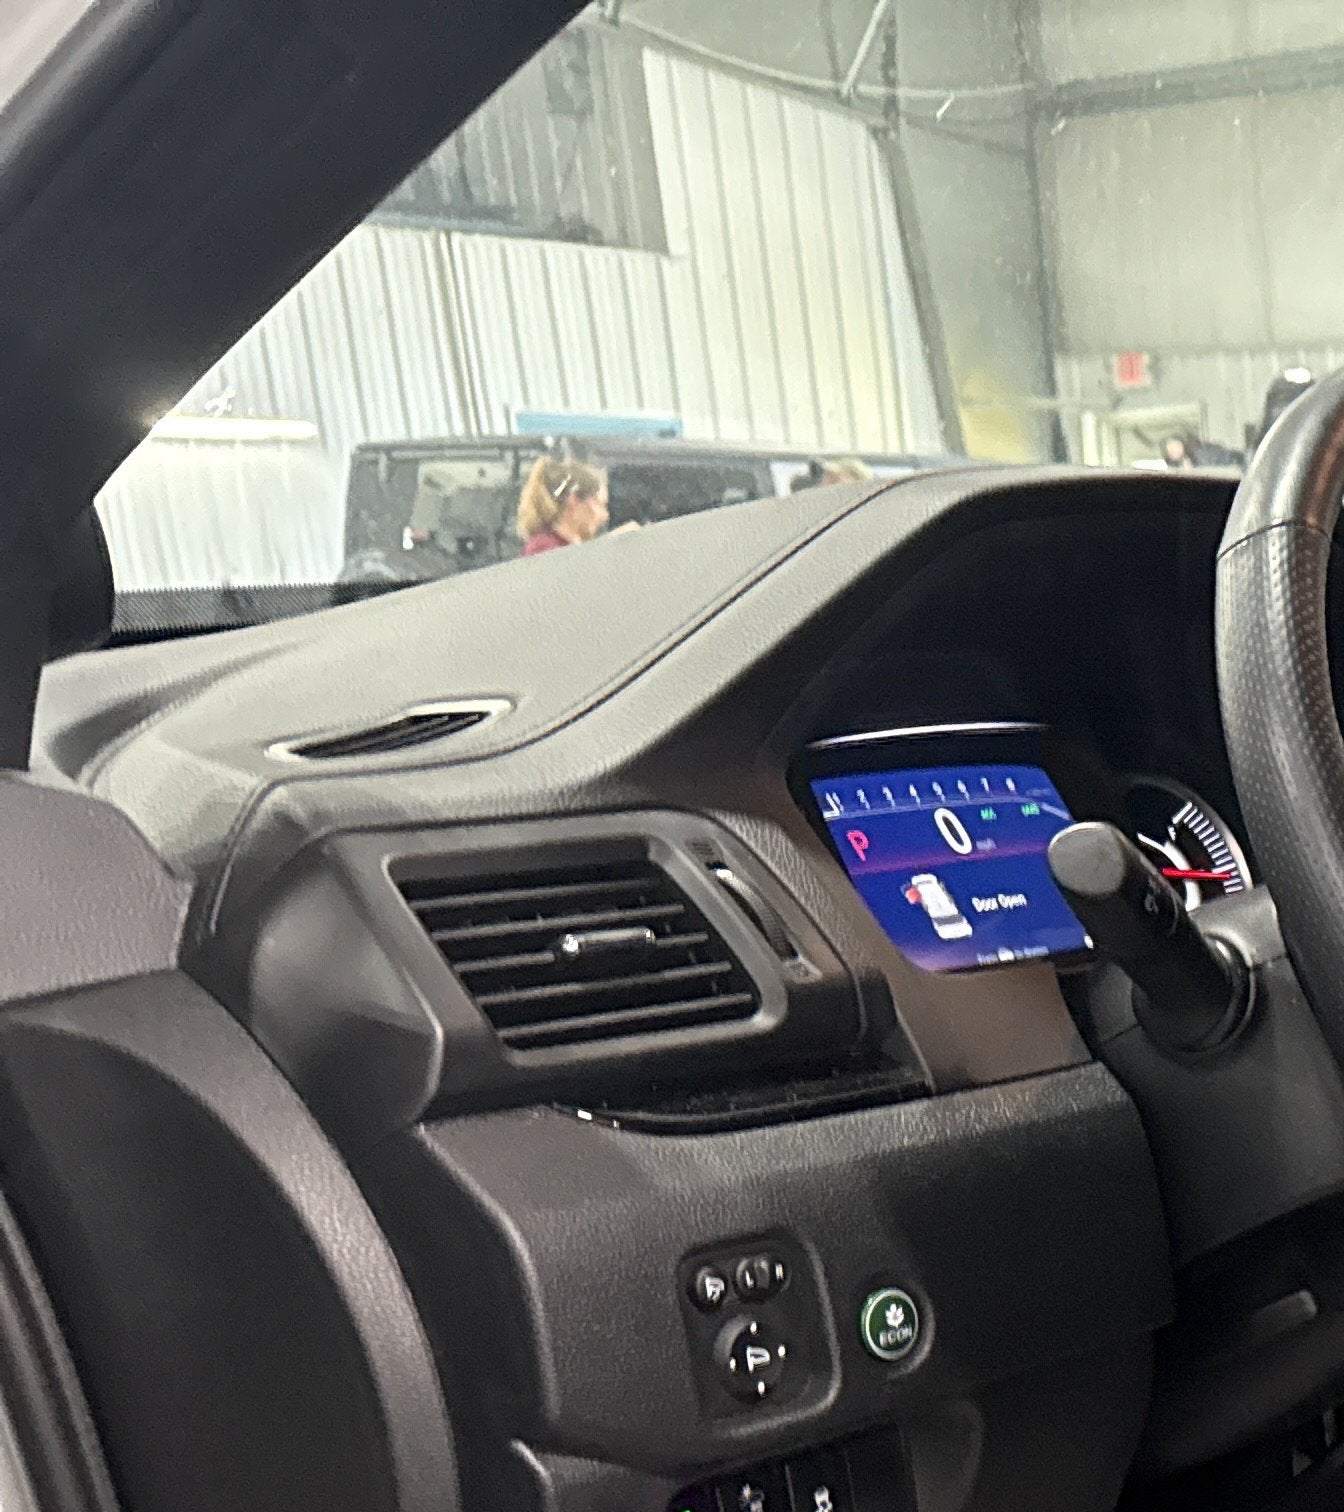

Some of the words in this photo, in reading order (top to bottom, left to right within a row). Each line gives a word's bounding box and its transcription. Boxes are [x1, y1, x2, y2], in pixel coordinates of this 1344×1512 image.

[846, 829, 870, 861] P
[933, 807, 974, 855] 0
[997, 893, 1028, 911] Open
